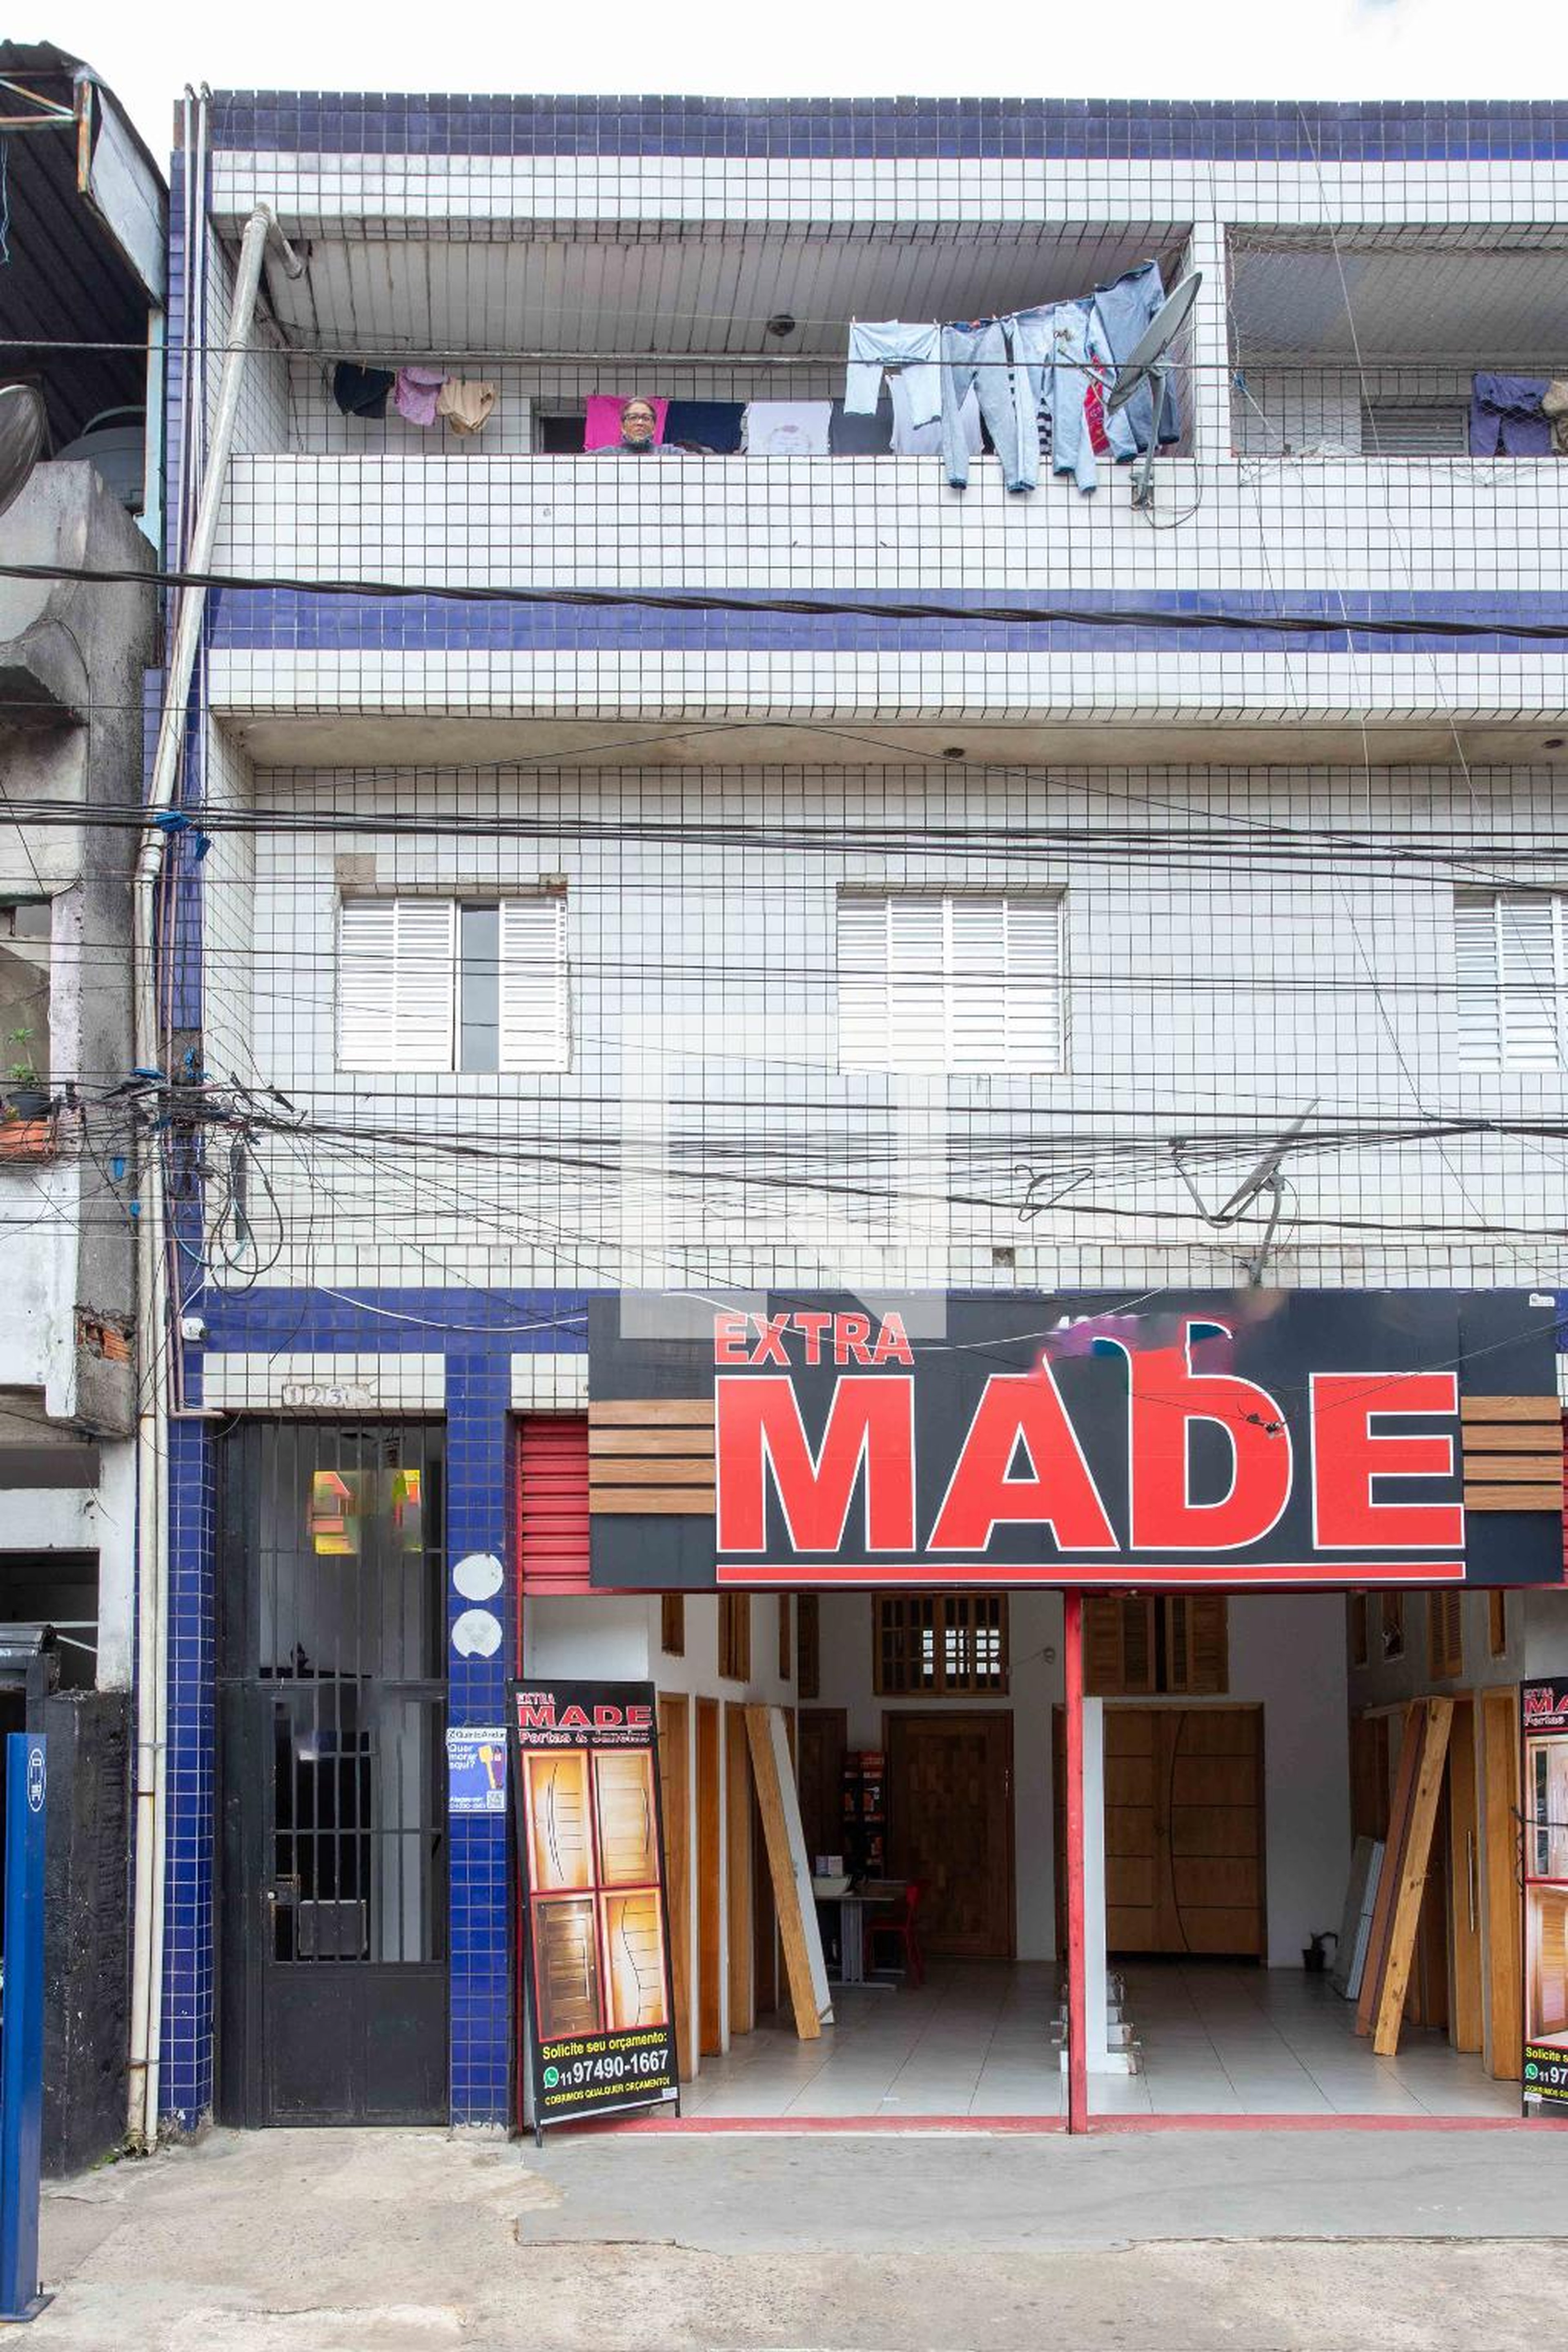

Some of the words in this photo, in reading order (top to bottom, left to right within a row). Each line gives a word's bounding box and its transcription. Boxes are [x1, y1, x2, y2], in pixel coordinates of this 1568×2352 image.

[714, 1312, 915, 1366] EXTRA
[715, 1371, 1466, 1552] MADE
[517, 1705, 653, 1727] MADE
[518, 1731, 572, 1744] Portas
[542, 2042, 584, 2060] Solicite
[586, 2040, 606, 2053] seu
[608, 2031, 667, 2051] orçamento:
[1526, 2047, 1561, 2061] Solicite
[545, 2090, 584, 2105] COBRIMOS
[585, 2083, 624, 2099] QUALQUER
